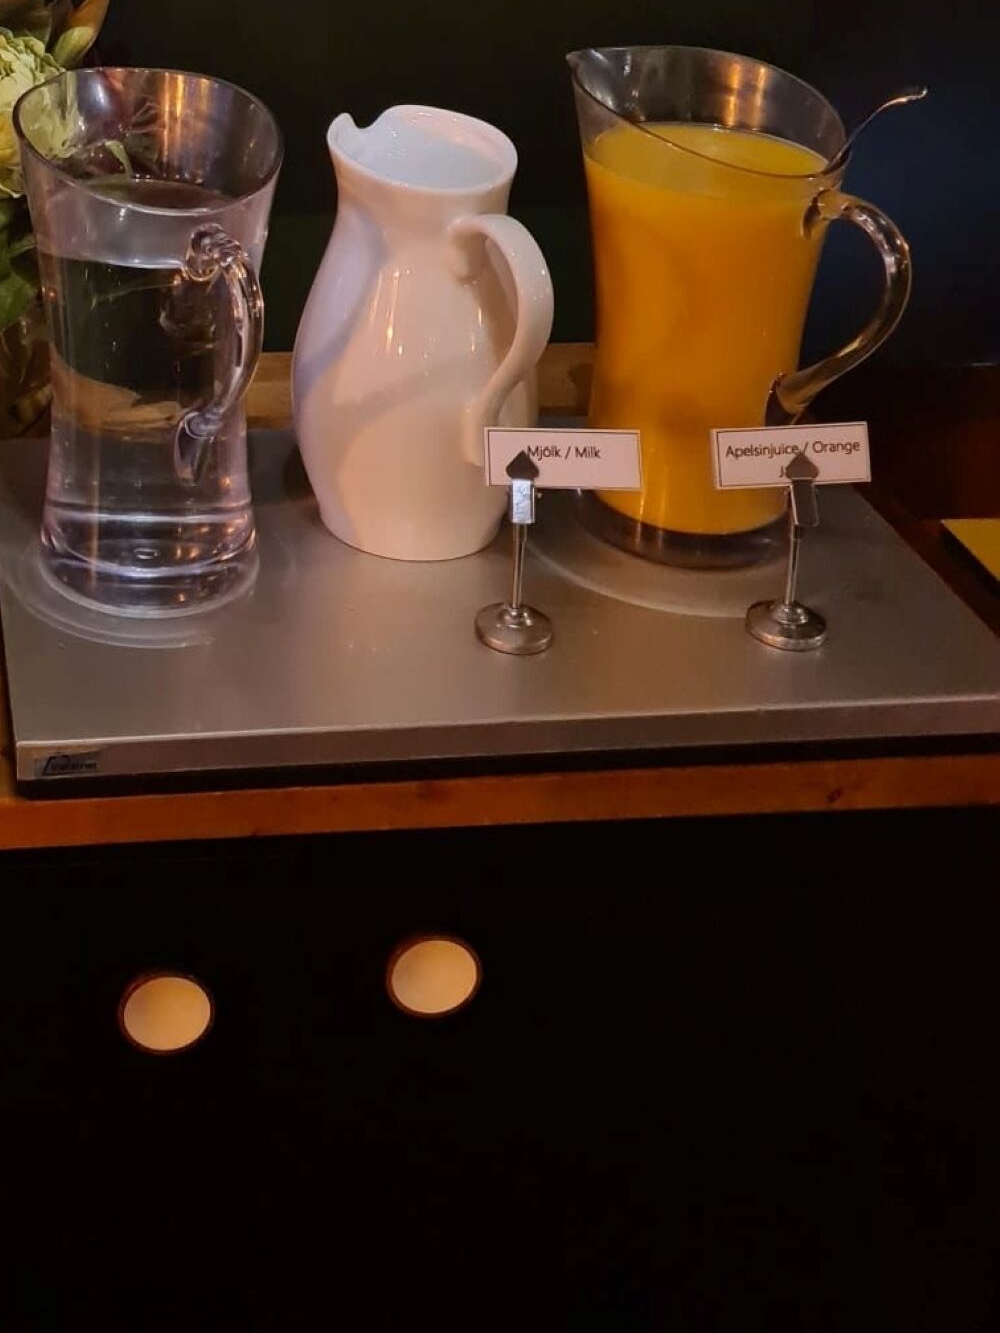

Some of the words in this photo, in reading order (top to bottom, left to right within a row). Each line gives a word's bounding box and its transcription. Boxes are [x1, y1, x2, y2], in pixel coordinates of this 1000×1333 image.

[527, 445, 561, 461] Mjölk
[565, 446, 571, 459] /
[575, 446, 600, 458] Milk
[726, 444, 799, 459] Apelsinjuice
[813, 441, 860, 455] Orange
